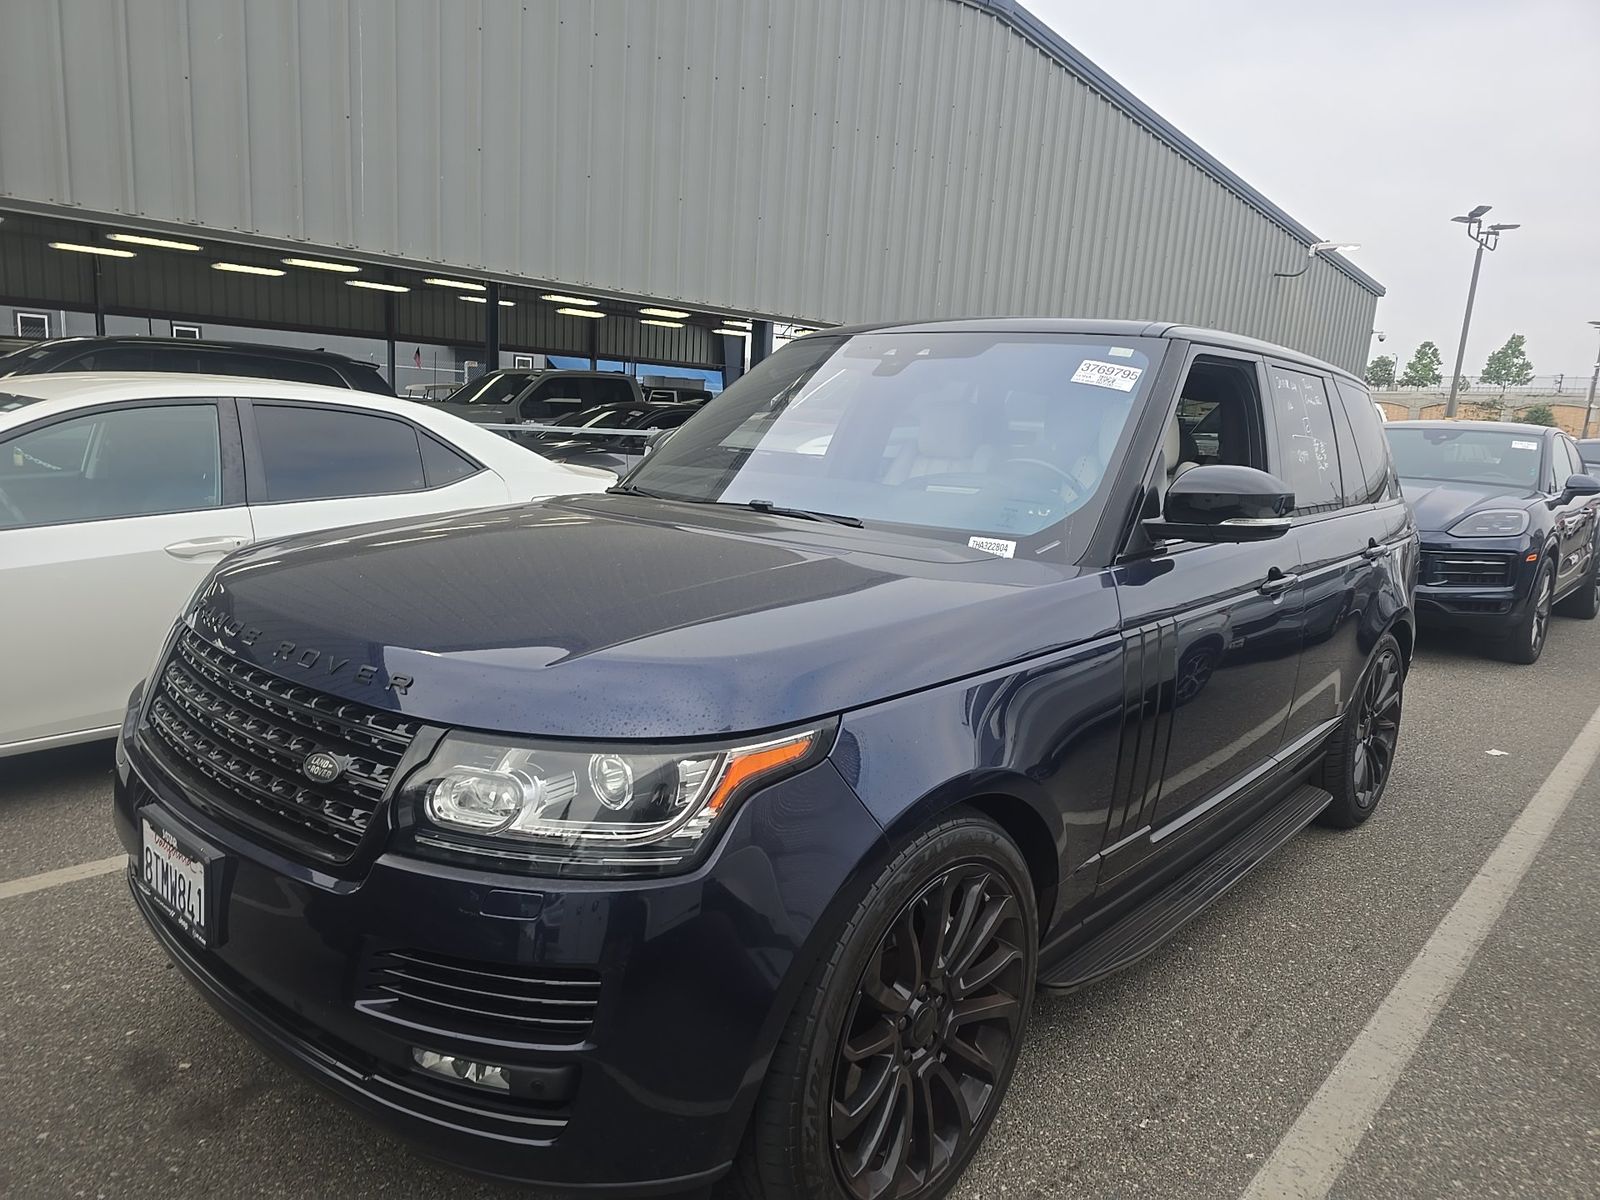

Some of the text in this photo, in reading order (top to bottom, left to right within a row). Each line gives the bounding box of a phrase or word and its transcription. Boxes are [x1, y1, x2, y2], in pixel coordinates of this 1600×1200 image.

[1080, 362, 1139, 381] 3769795
[972, 540, 1009, 552] THA322804
[273, 640, 415, 696] ROVER
[311, 756, 330, 769] LAND
[310, 765, 333, 779] ROVER
[144, 846, 204, 928] 8TMW841
